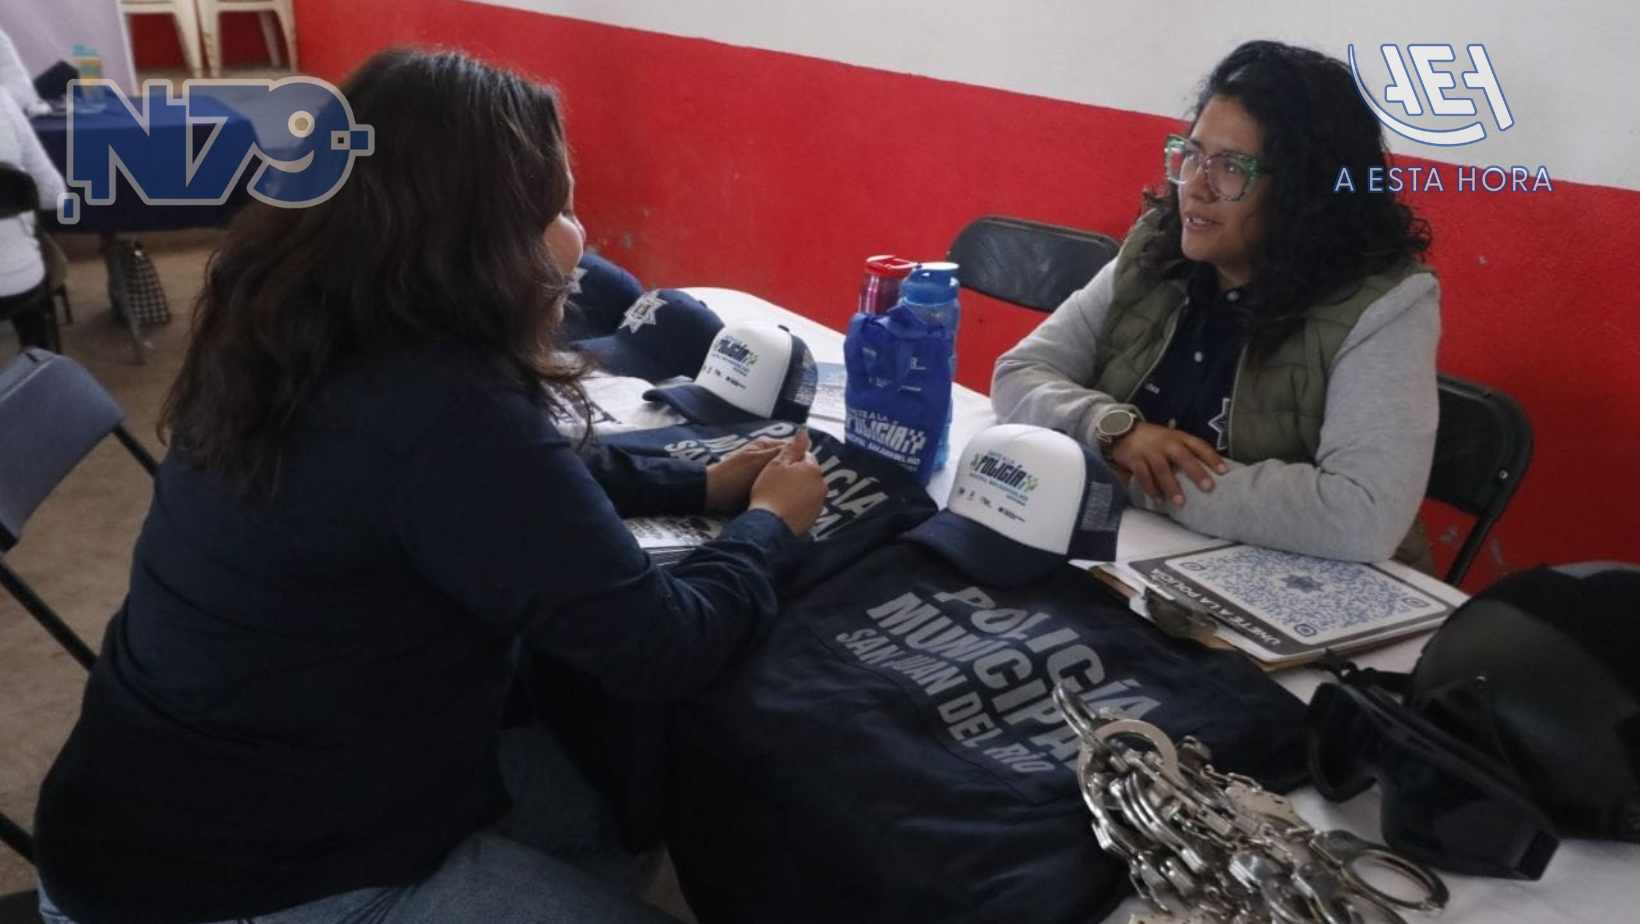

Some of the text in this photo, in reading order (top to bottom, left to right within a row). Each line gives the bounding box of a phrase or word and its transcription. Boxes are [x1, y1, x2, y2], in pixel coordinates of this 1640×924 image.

[750, 421, 890, 517] PICÍA
[865, 592, 1080, 772] MUNICIPA
[933, 586, 1161, 720] POLICÍA
[936, 690, 1004, 748] DEL
